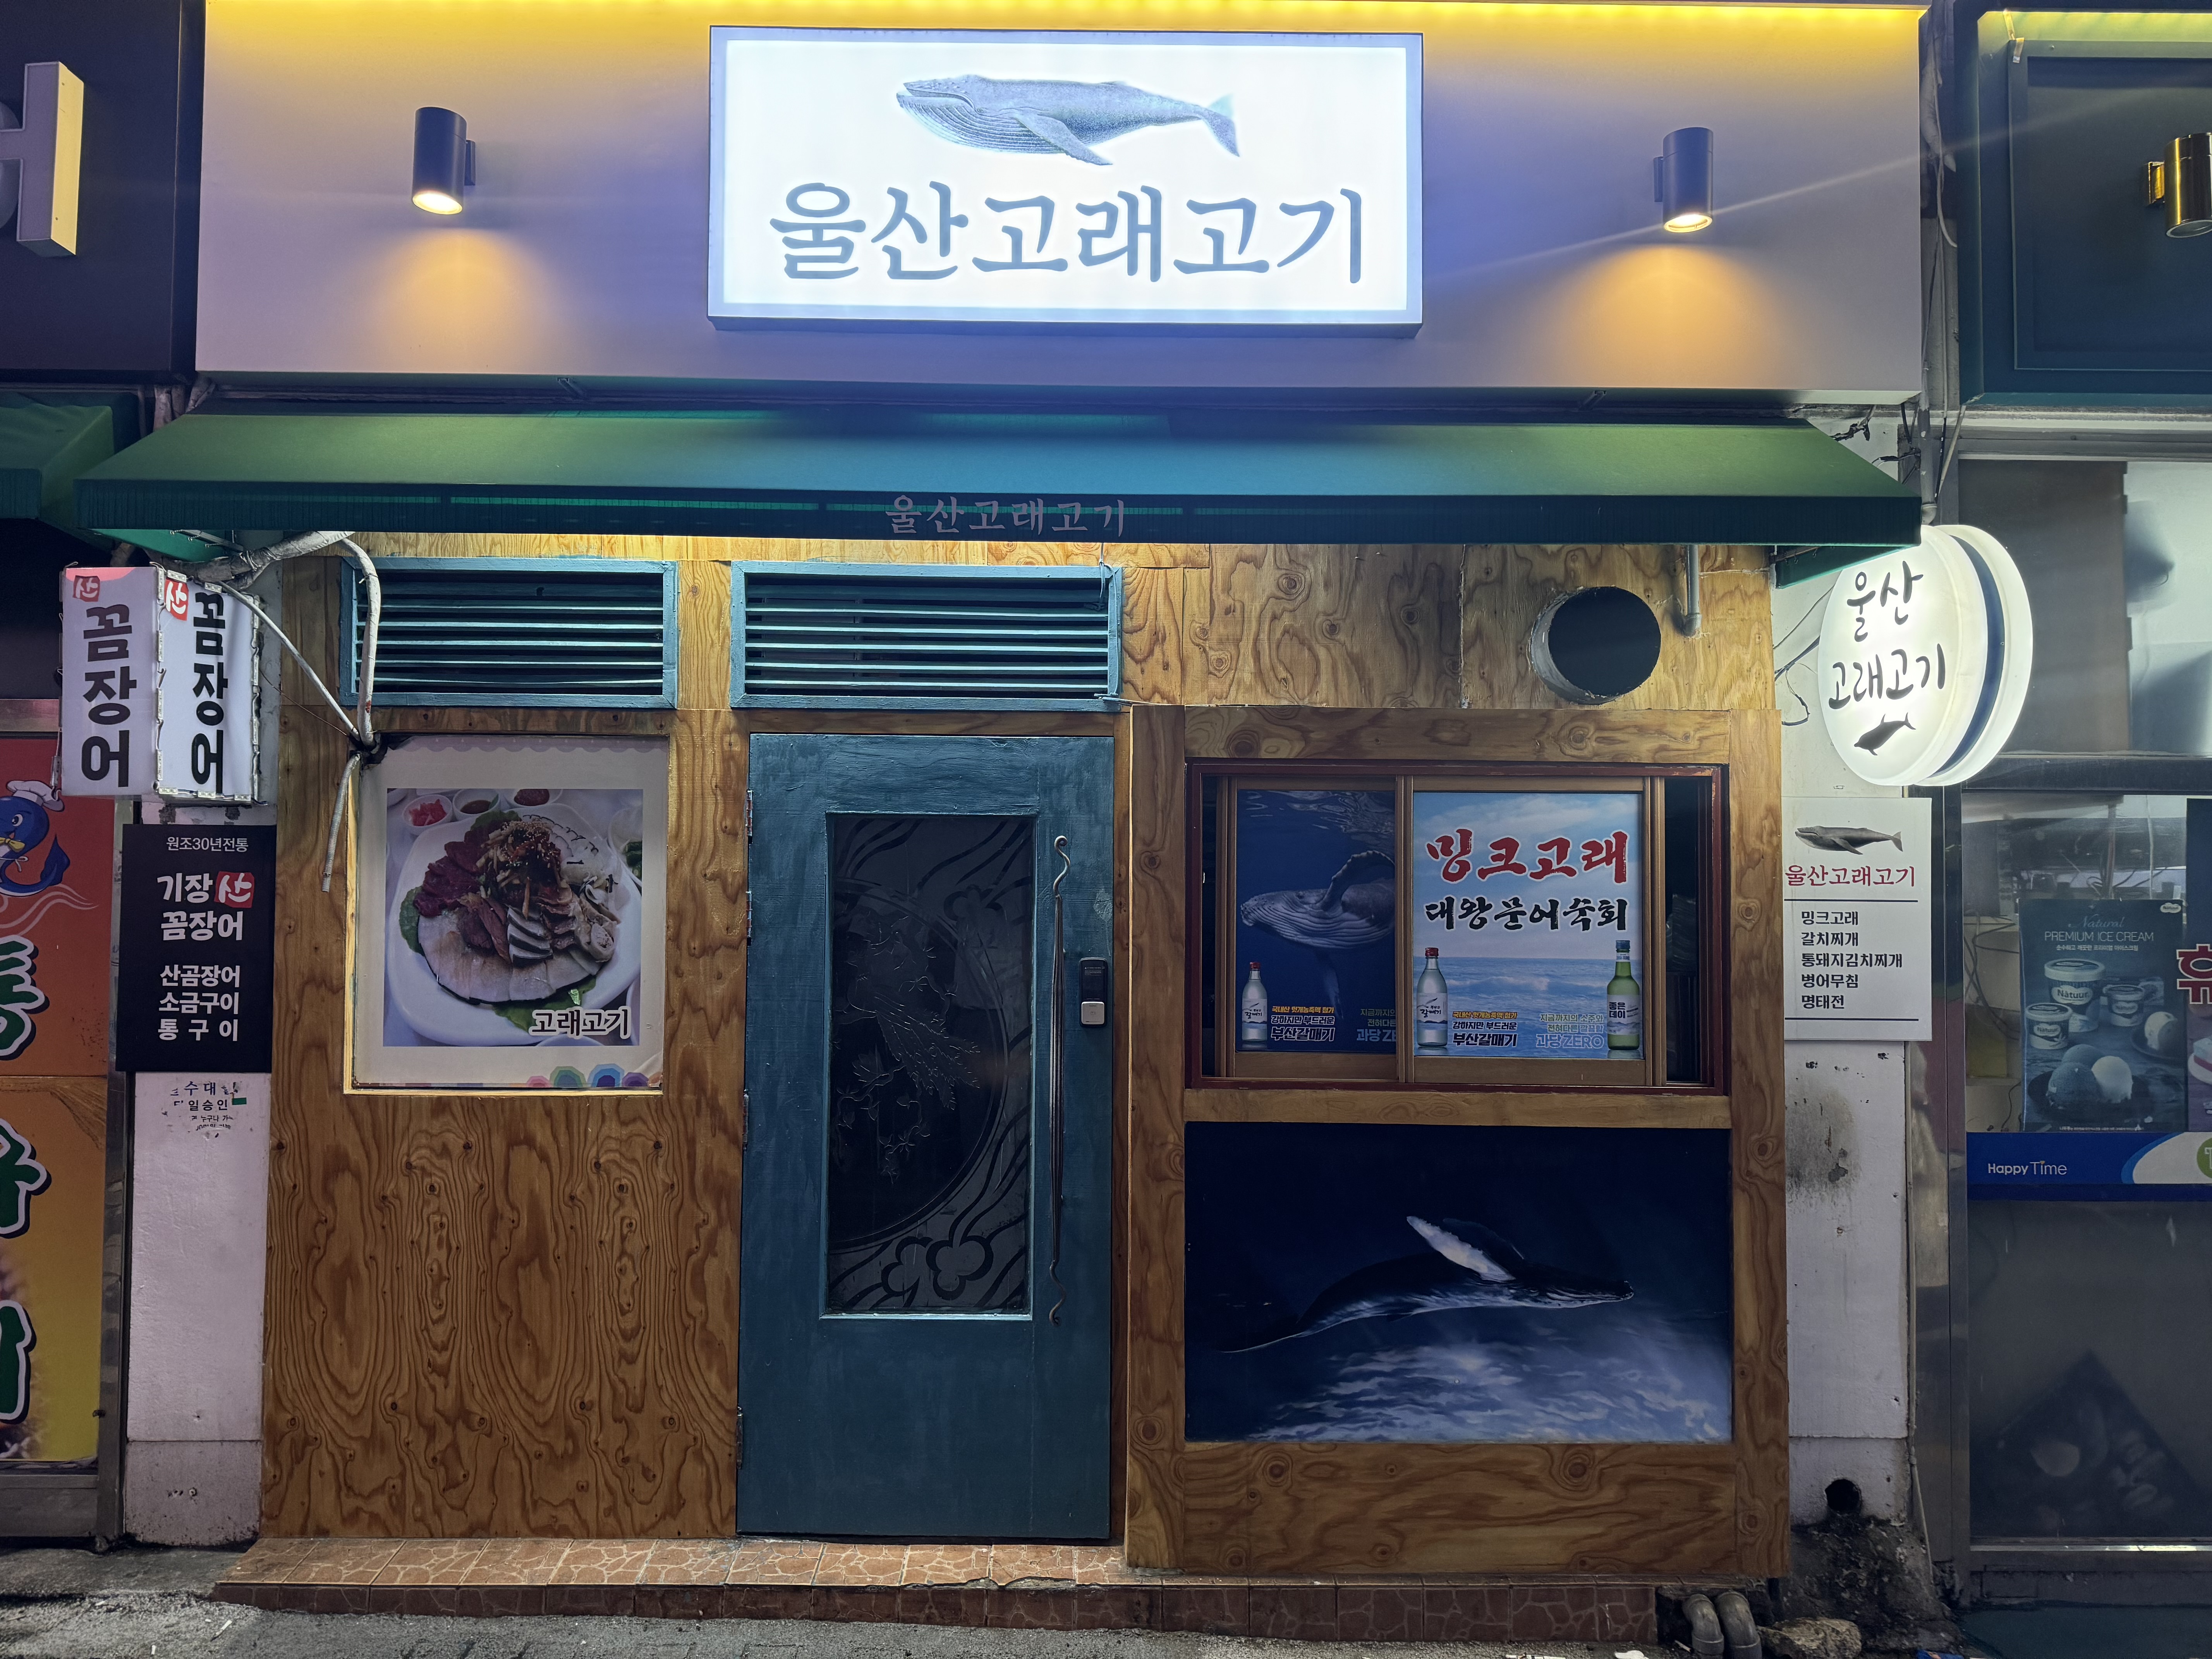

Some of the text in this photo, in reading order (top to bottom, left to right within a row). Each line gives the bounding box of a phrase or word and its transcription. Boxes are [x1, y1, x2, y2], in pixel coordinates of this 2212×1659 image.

[770, 180, 1362, 284] 울산고래고기
[885, 495, 1124, 537] 울산고래고기
[75, 577, 98, 598] 산
[166, 581, 187, 614] 산
[1847, 561, 1923, 642] 울산
[1828, 643, 1946, 709] 고래고기
[82, 604, 137, 788] 꼼장어
[192, 592, 228, 794] 꼼장어
[166, 836, 249, 852] 원조30년전통
[1426, 828, 1628, 883] 밍크고래
[1785, 865, 1914, 887] 울산고래고기
[157, 872, 213, 903] 기장
[161, 911, 243, 941] 꼼장어
[1802, 911, 1858, 925] 밍크고래
[2068, 914, 2125, 927] Natural
[1801, 932, 1858, 946] 갈치찌개
[2045, 931, 2154, 942] PREMIUM ICE CREAM
[1801, 953, 1902, 968] 통돼지김치찌개
[160, 964, 240, 988] 산곰장어
[1801, 974, 1858, 988] 병어무침
[158, 992, 239, 1015] 소금구이
[1801, 994, 1844, 1009] 명태전
[531, 1009, 628, 1036] 고래고기
[1271, 1015, 1335, 1025] 강하지만 부드러운
[1539, 1013, 1604, 1023] 지금까지의 소주와
[1609, 1010, 1625, 1018] 데이
[1271, 1026, 1335, 1041] 부산갈매기
[1452, 1021, 1517, 1030] 강하지만 부드러운
[1453, 1032, 1518, 1047] 부산갈매기
[1988, 1161, 2068, 1175] Happy Time
